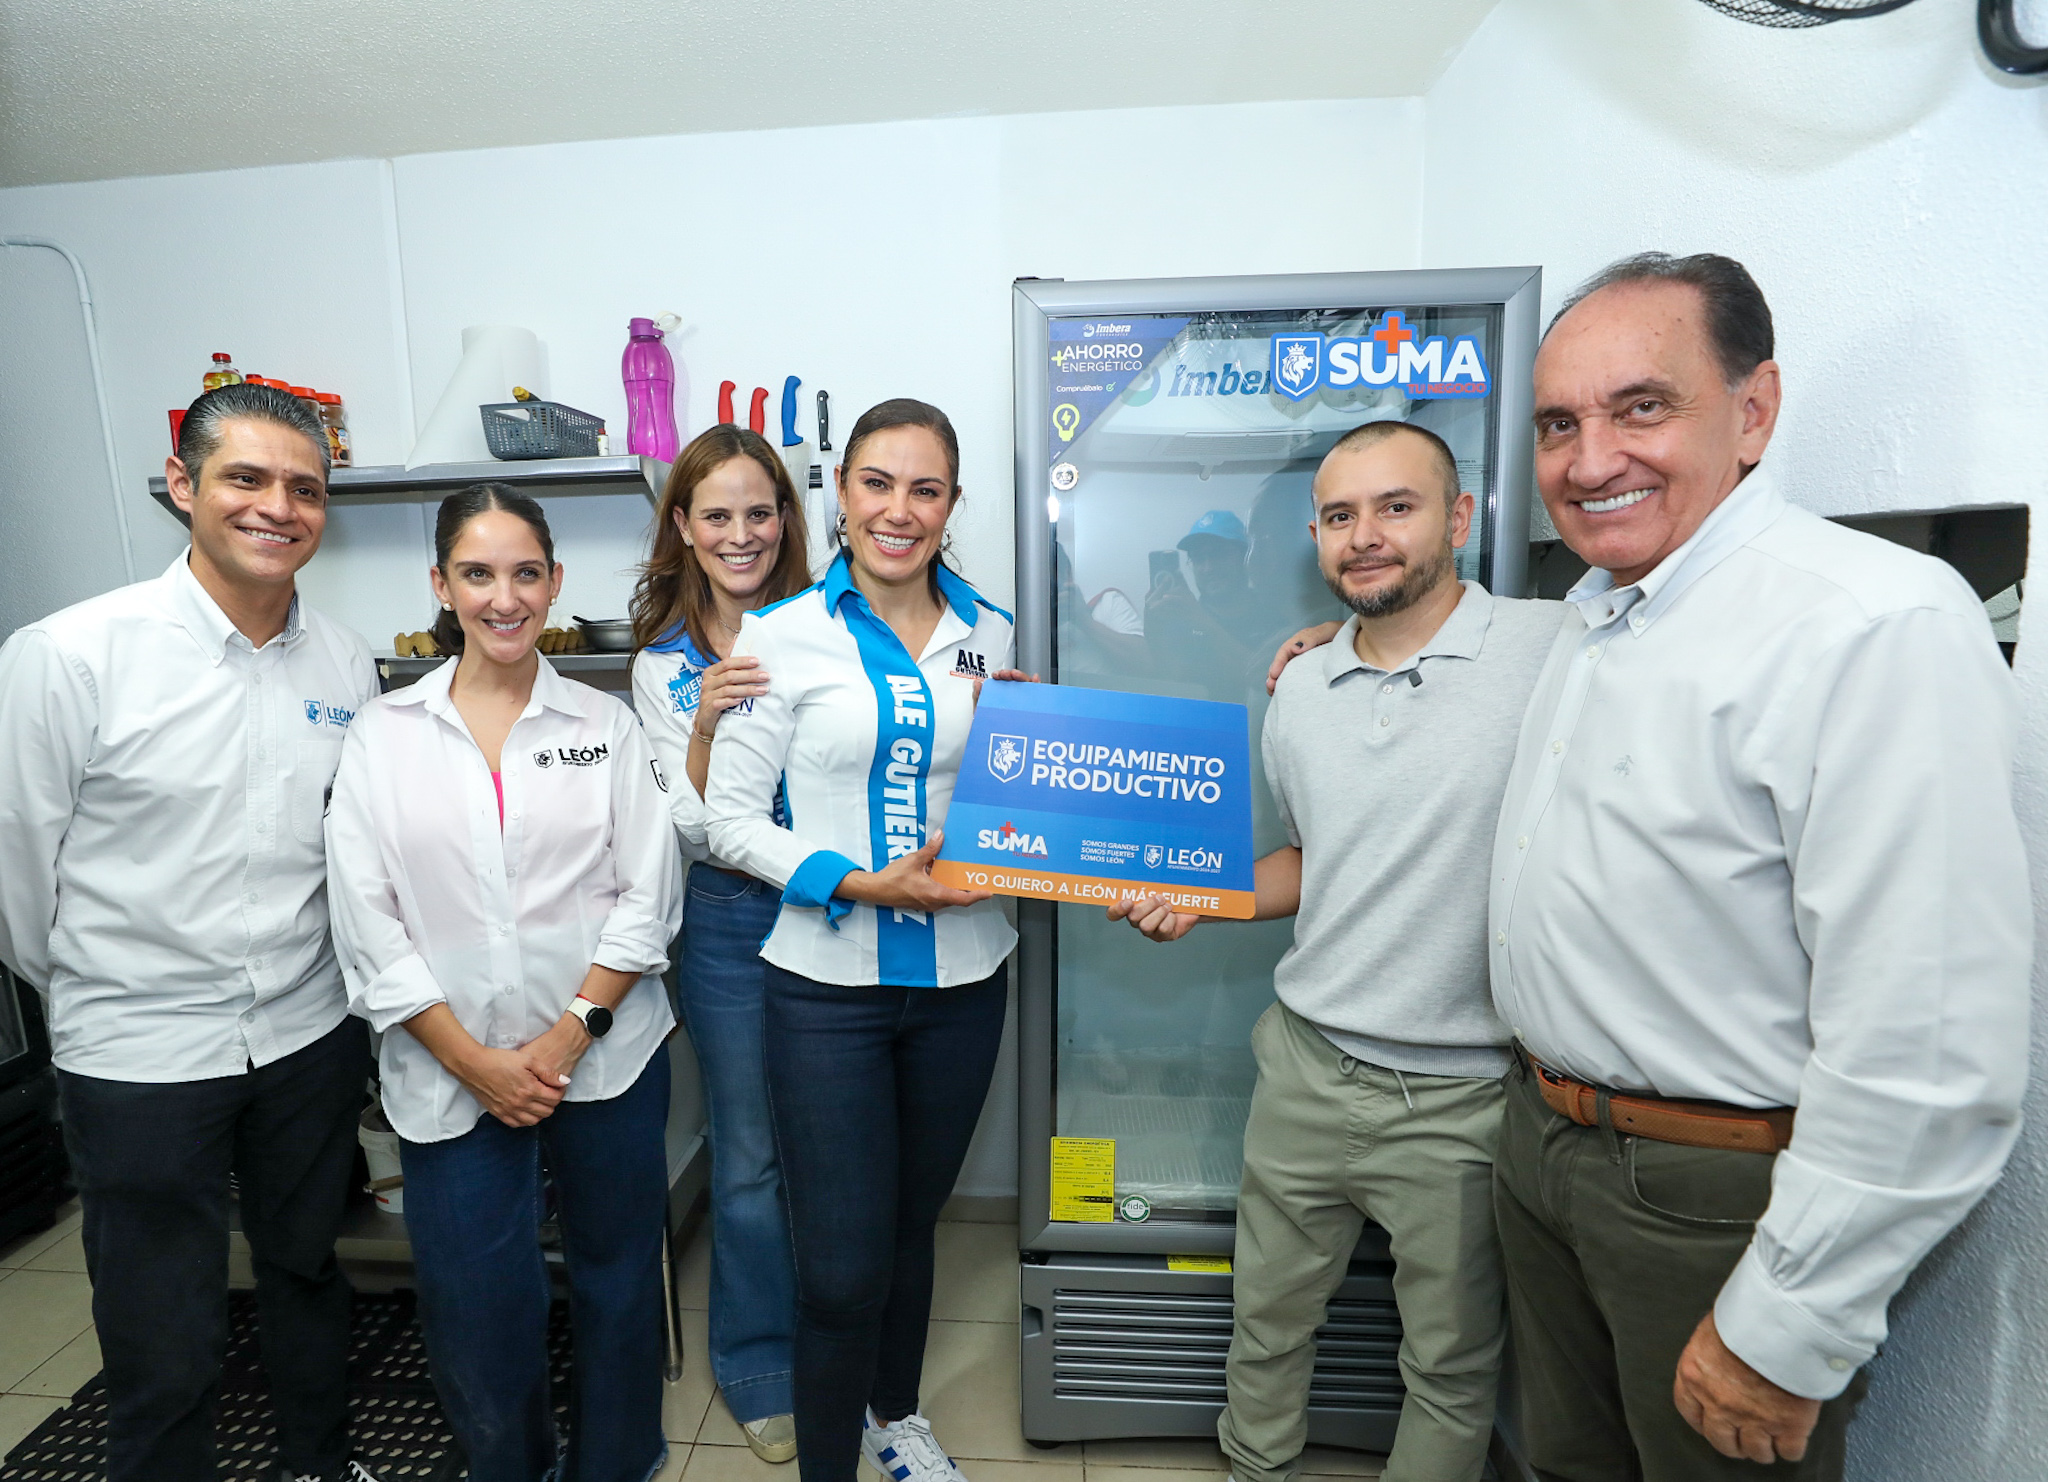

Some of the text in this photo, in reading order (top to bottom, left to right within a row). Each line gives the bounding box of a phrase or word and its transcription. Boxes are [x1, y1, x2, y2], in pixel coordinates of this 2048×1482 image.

[1095, 323, 1132, 334] Imbera
[1062, 343, 1143, 360] AHORRO
[1062, 359, 1143, 373] ENERGÉTICO
[1329, 340, 1486, 386] SUMA
[1056, 384, 1103, 392] Compruébalo
[1168, 363, 1281, 397] Imber
[1407, 383, 1487, 394] TU NEGOCIO
[956, 649, 986, 673] ALE
[669, 675, 704, 701] QUIER
[326, 706, 356, 723] LEÓN
[558, 743, 609, 762] LEÓN
[1033, 739, 1226, 778] EQUIPAMIENTO
[1031, 763, 1222, 804] PRODUCTIVO
[883, 674, 928, 927] ALE GUTIÉRZ
[978, 829, 1048, 855] SUMA
[1081, 840, 1140, 851] SOMOS GRANDES
[1080, 847, 1135, 858] SOMOS FUERTES
[1080, 854, 1125, 864] SOMOS LEÓN
[1167, 847, 1223, 868] LEÓN
[965, 871, 988, 886] YO
[992, 874, 1054, 893] QUIERO
[1057, 882, 1069, 895] A
[1074, 883, 1117, 899] LEÓN
[1162, 892, 1220, 909] FUERTE
